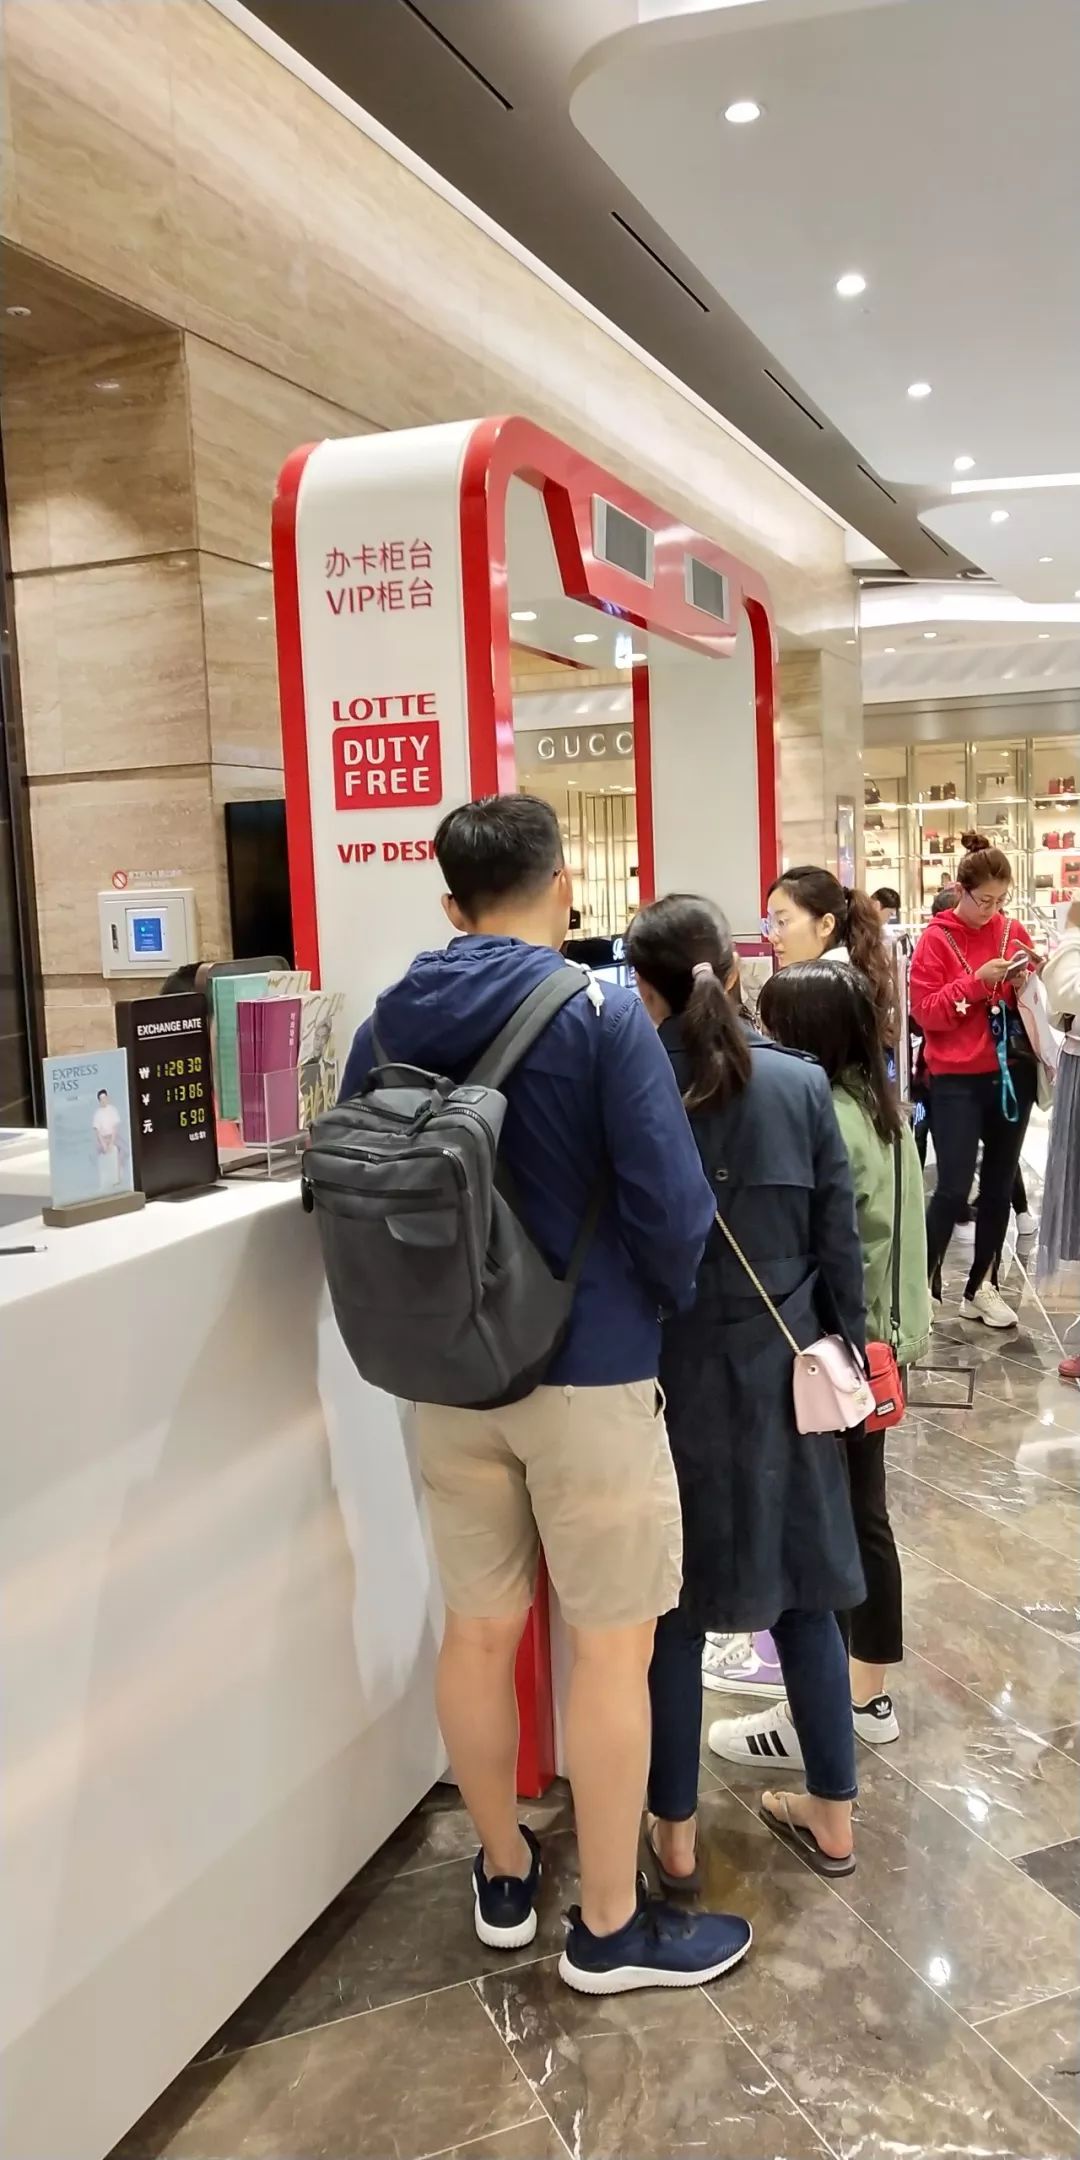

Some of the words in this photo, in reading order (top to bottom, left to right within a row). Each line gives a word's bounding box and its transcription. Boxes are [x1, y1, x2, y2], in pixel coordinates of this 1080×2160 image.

[325, 538, 432, 578] 办卡柜台
[325, 577, 433, 615] VIP柜台
[332, 693, 437, 722] LOTTE
[343, 735, 430, 766] DUTY
[344, 767, 430, 796] FREE
[337, 843, 376, 864] VIP
[137, 1021, 181, 1036] EXCHANGE
[182, 1018, 202, 1030] RATE
[52, 1064, 99, 1080] EXPRESS
[53, 1080, 79, 1092] PASS
